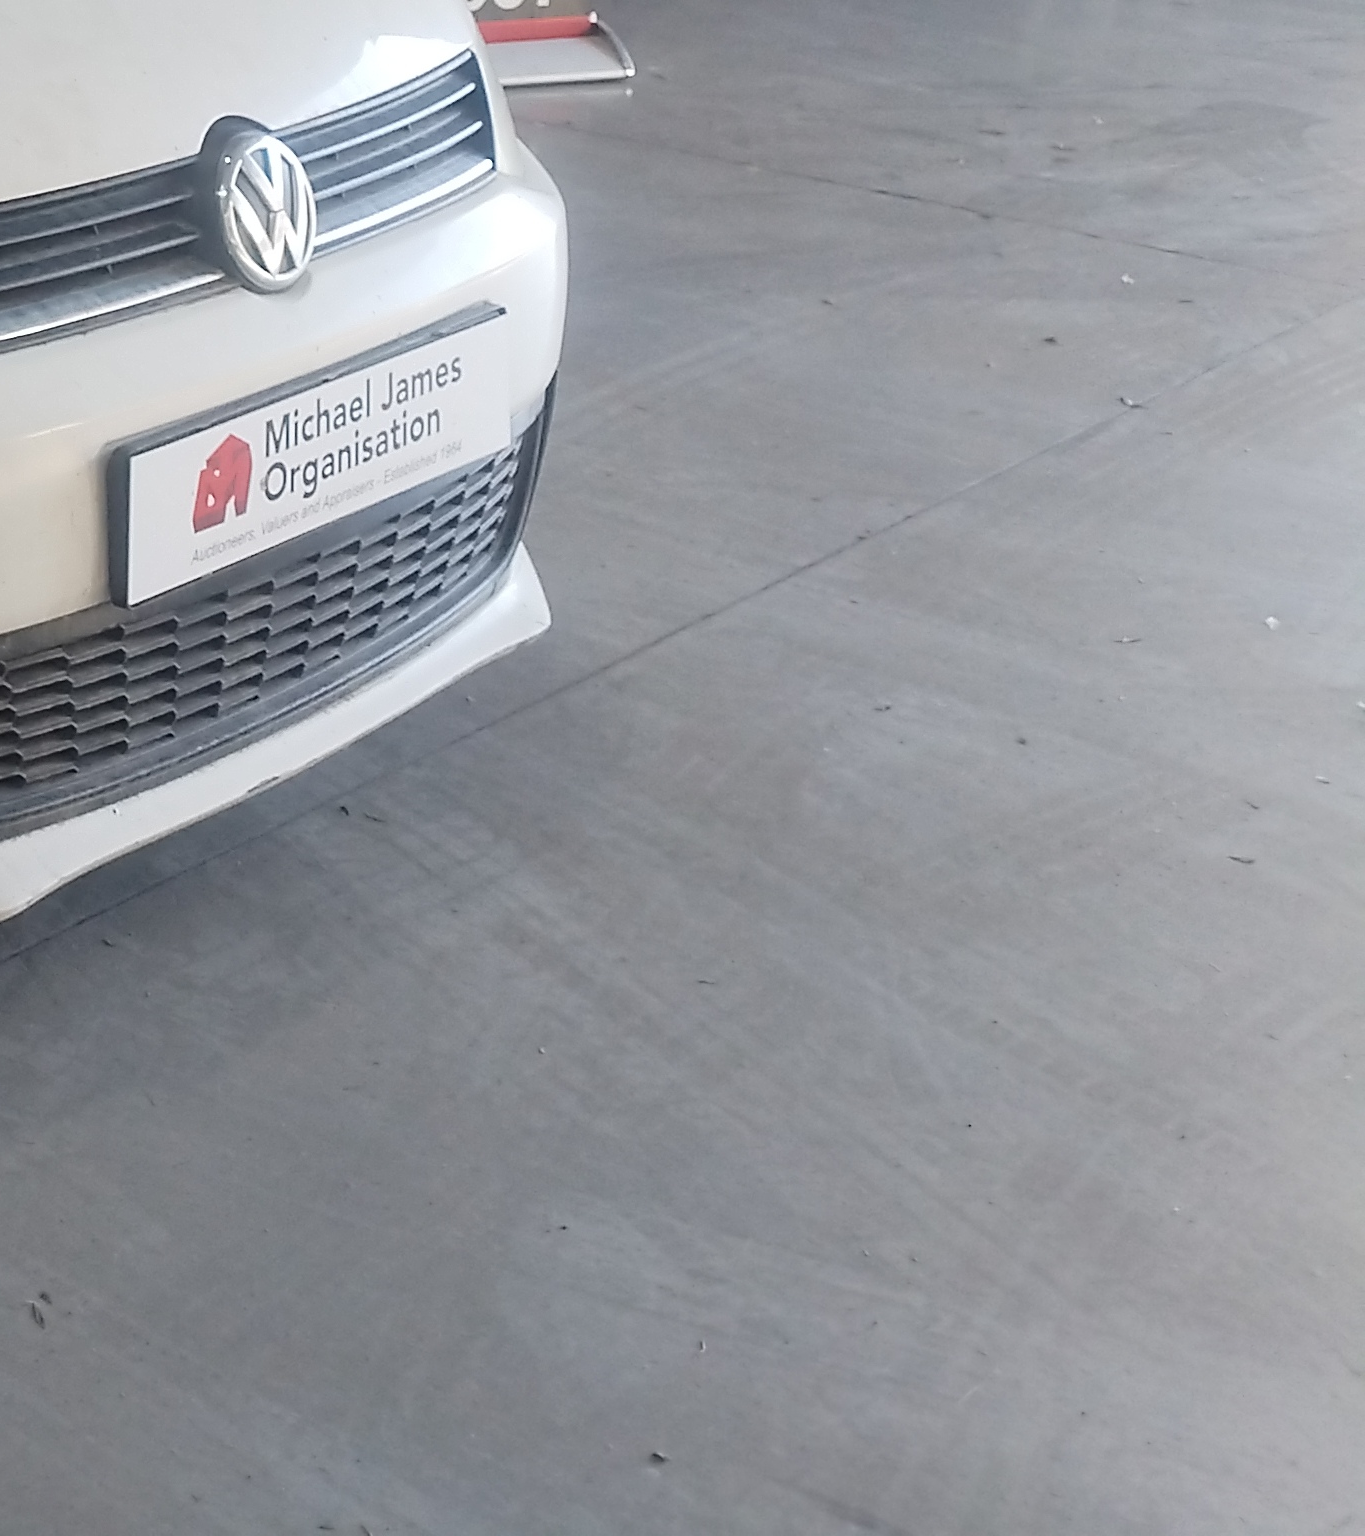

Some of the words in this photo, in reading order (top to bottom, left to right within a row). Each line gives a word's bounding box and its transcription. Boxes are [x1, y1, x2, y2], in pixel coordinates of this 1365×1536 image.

[264, 379, 370, 457] Michael
[381, 356, 462, 411] James
[264, 408, 441, 502] Organisation
